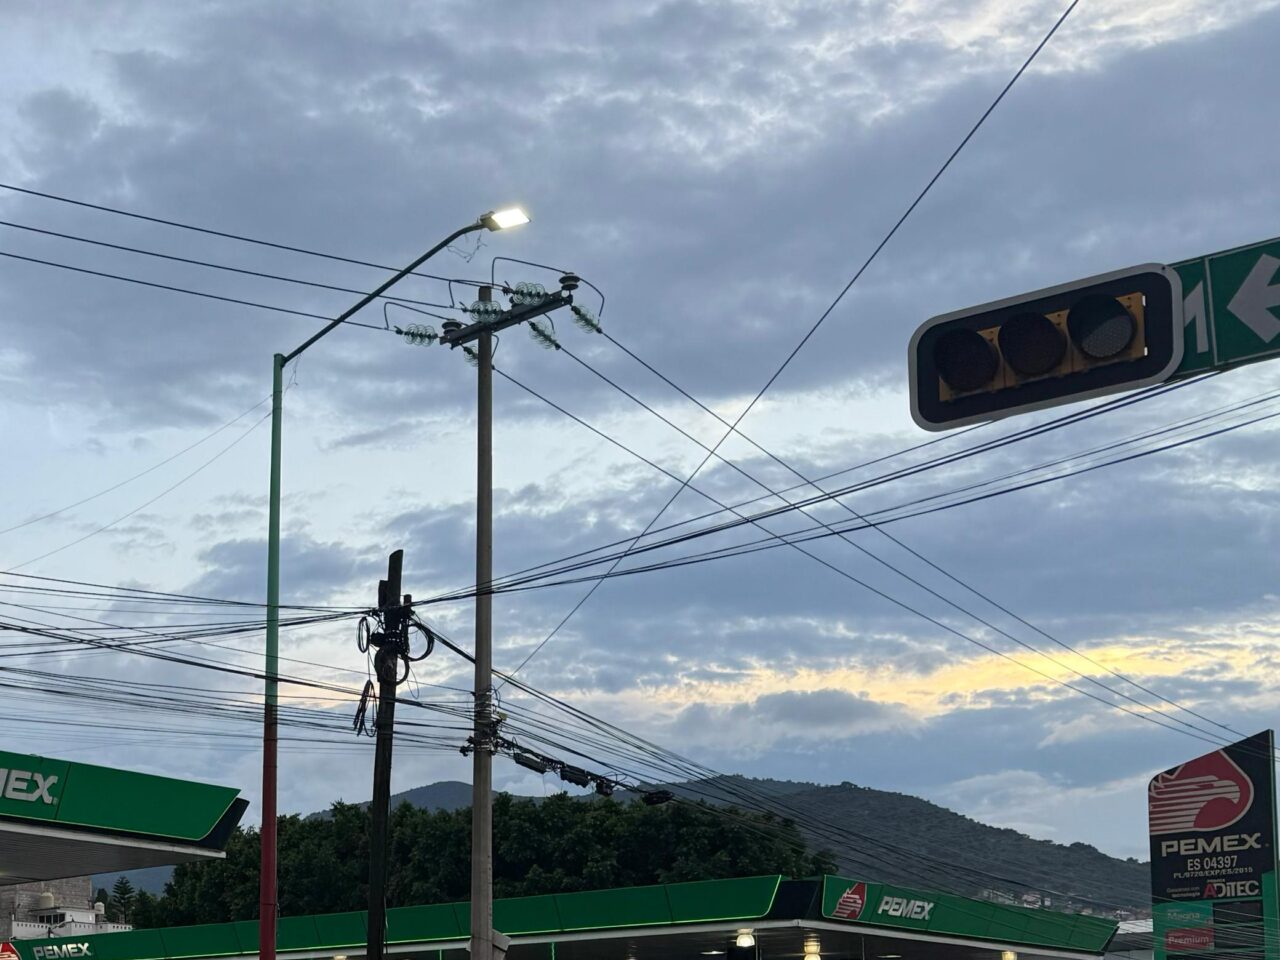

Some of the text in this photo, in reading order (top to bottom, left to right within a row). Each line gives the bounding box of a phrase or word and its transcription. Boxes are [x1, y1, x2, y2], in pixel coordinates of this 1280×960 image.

[1161, 832, 1262, 857] PEMEX
[1187, 855, 1238, 872] ES 04397
[877, 896, 935, 921] PEMEX
[32, 942, 92, 960] PEMEX
